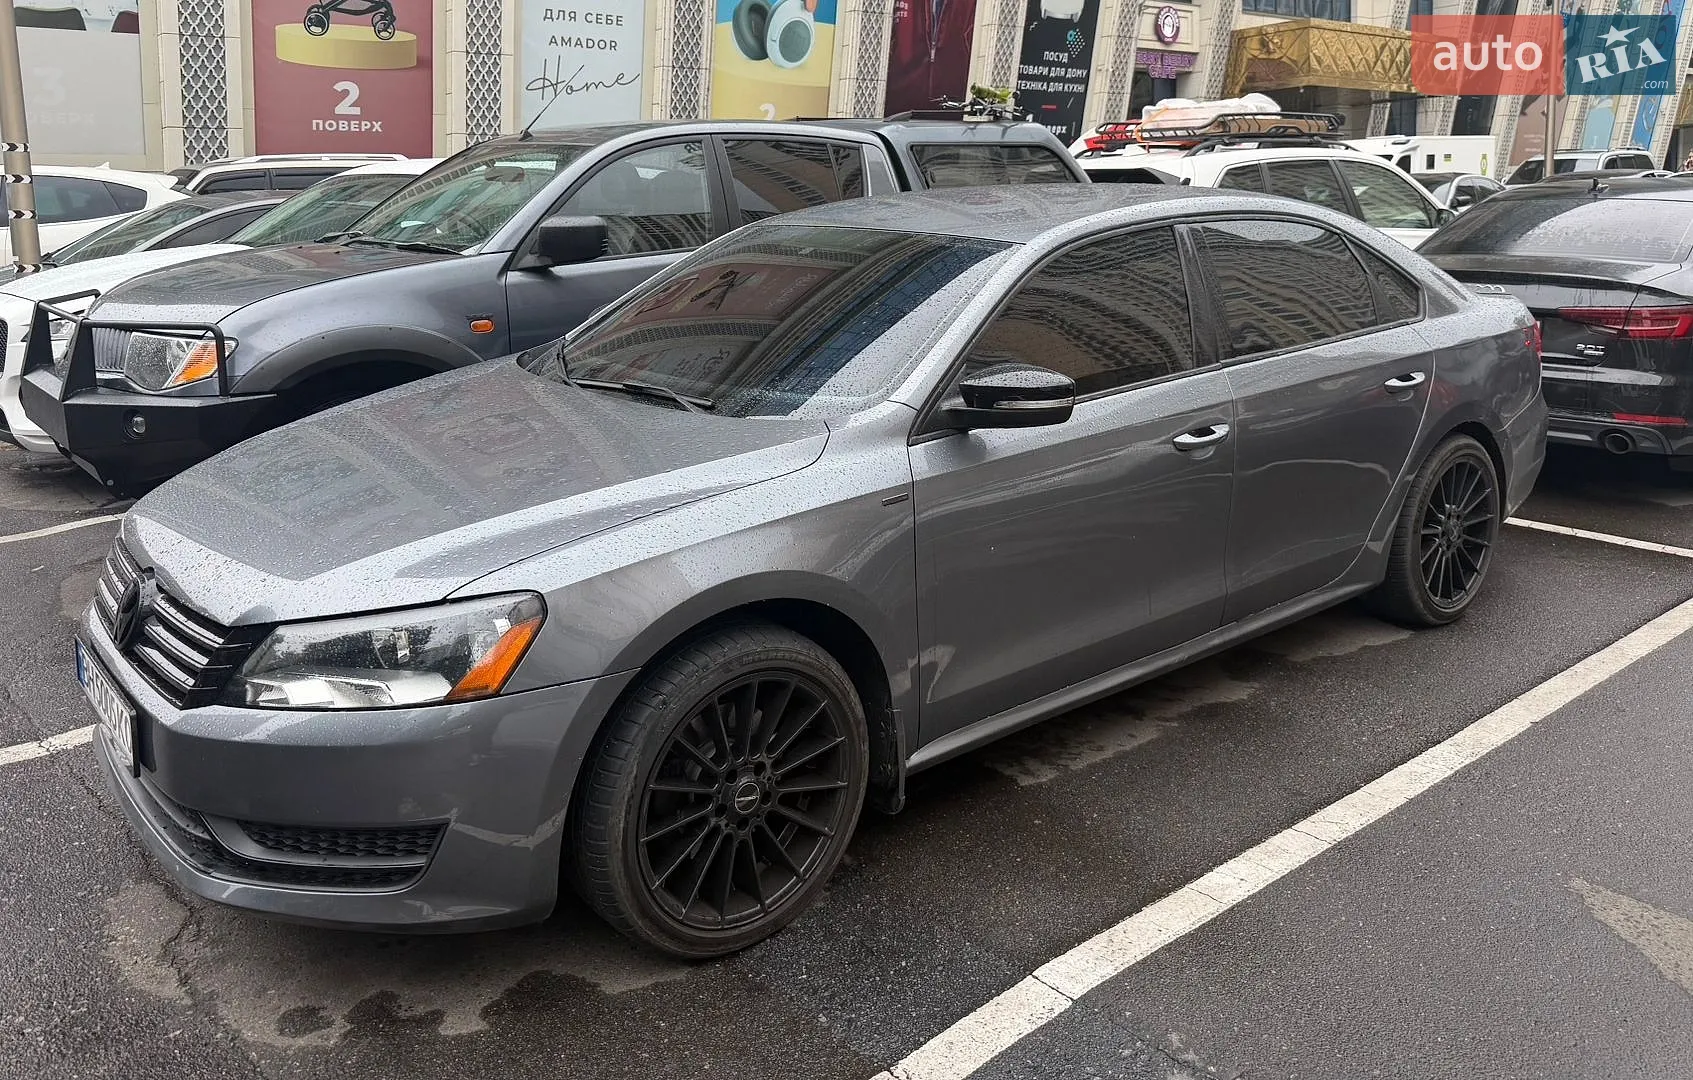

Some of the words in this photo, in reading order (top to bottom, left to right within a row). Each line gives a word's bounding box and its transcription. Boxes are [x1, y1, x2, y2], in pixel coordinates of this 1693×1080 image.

[543, 8, 577, 22] ДЛЯ
[584, 12, 623, 26] СЕБЕ
[548, 35, 618, 51] AMADOR
[1043, 51, 1068, 63] ПОСУД
[526, 55, 640, 100] Home
[1020, 64, 1049, 76] ТОВАРИ
[1050, 67, 1065, 78] ДЛЯ
[1066, 68, 1088, 79] ДОМУ
[1017, 80, 1047, 91] ТЕХНІКА
[1048, 82, 1063, 92] ДЛЯ
[1064, 83, 1085, 93] КУХНІ
[333, 81, 360, 114] 2
[312, 120, 383, 132] ПОВЕРХ
[1045, 124, 1067, 135] верх
